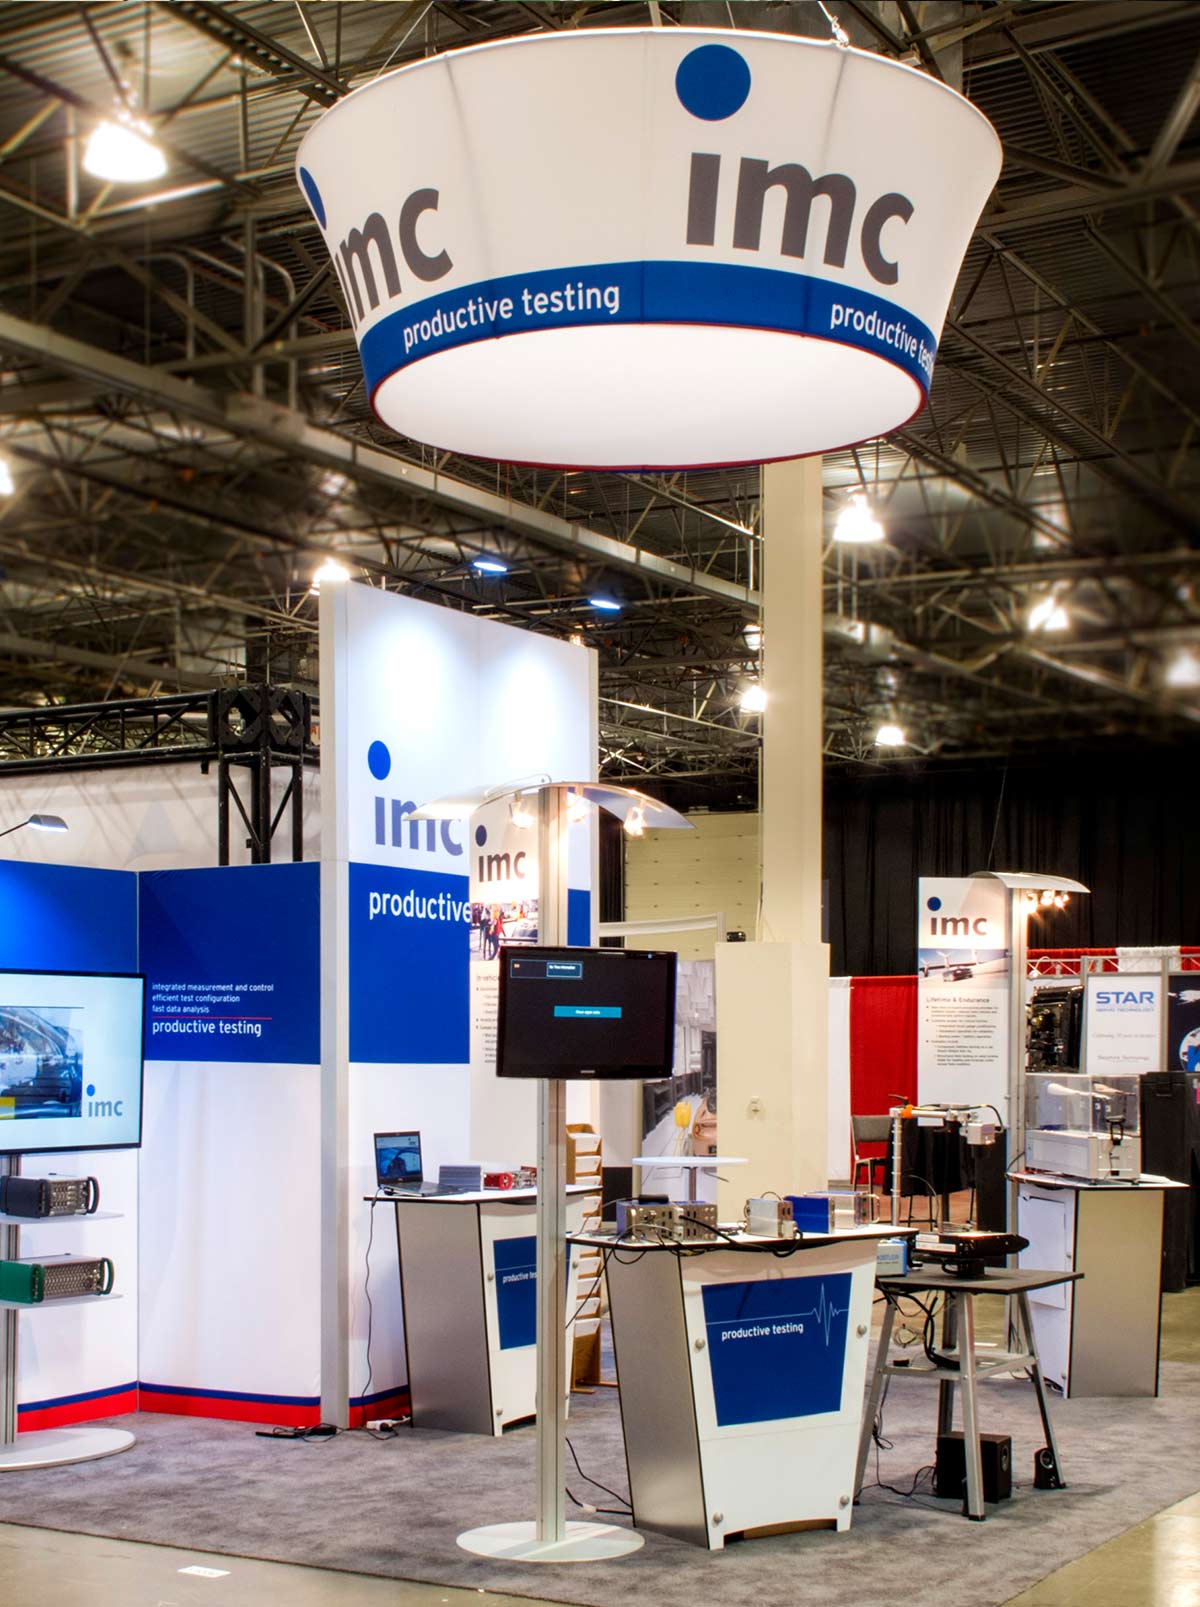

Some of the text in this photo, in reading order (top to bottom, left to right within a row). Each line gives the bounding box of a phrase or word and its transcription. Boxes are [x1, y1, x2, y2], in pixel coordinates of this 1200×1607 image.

[675, 44, 914, 285] imc
[299, 166, 453, 331] imc
[403, 282, 620, 354] productive testing
[830, 303, 917, 358] productive
[368, 740, 463, 856] imc
[475, 824, 526, 883] imc
[369, 889, 471, 924] productive
[927, 896, 988, 936] imc
[152, 983, 274, 992] integrated measurement and control
[152, 994, 240, 1003] efficient test configuration
[1096, 991, 1154, 1004] STAR
[152, 1004, 210, 1014] fast data analysis
[152, 1020, 262, 1037] productive testing
[87, 1084, 123, 1117] imc
[502, 1272, 528, 1285] productive
[721, 1322, 804, 1342] productive testing
